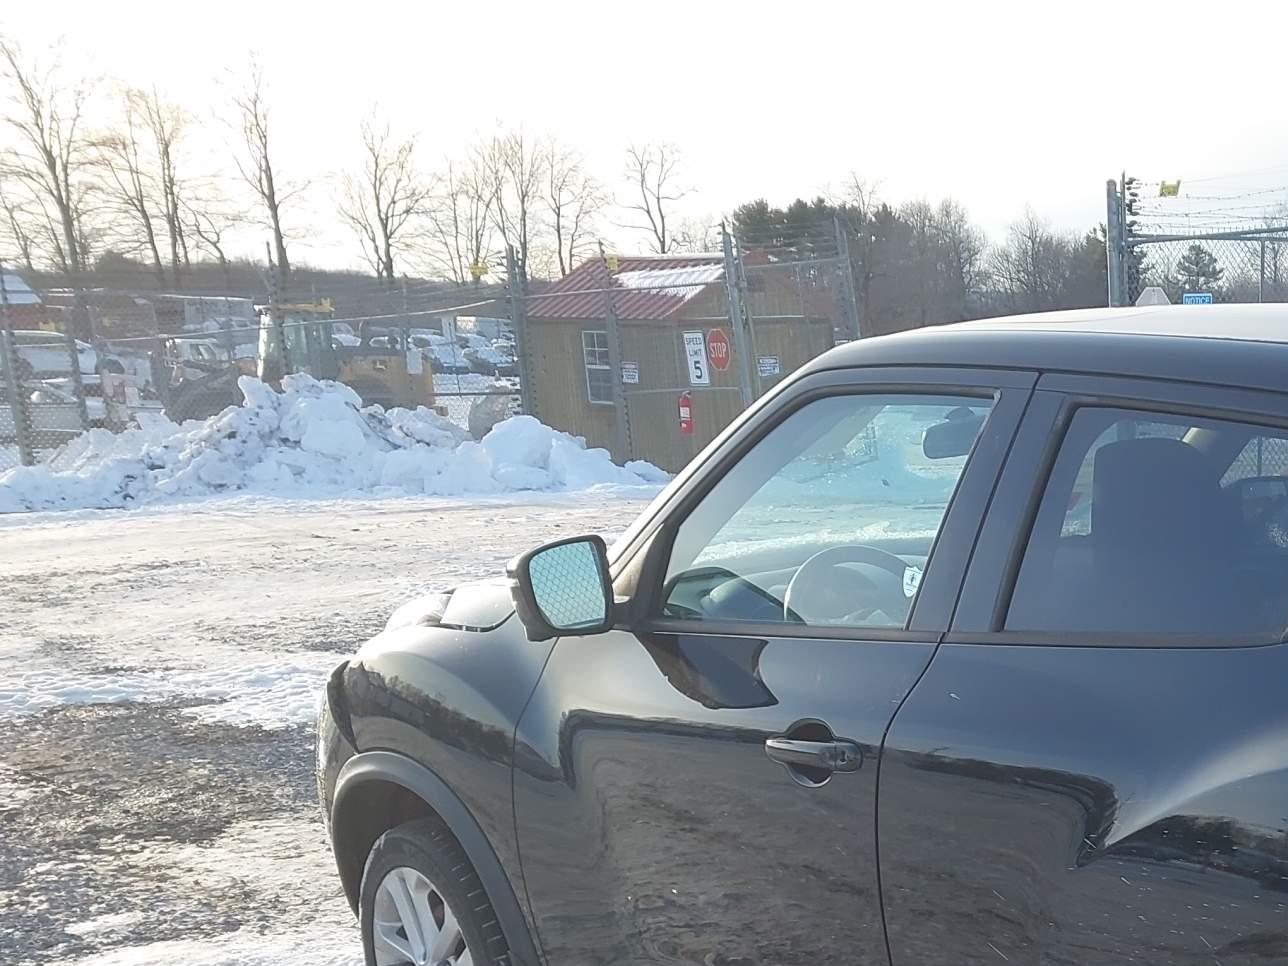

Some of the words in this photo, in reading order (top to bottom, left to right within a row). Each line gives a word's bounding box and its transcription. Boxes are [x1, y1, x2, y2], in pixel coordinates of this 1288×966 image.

[685, 337, 702, 346] SPEED
[688, 348, 702, 357] LIMIT
[710, 342, 727, 358] STOP
[693, 360, 703, 379] 5
